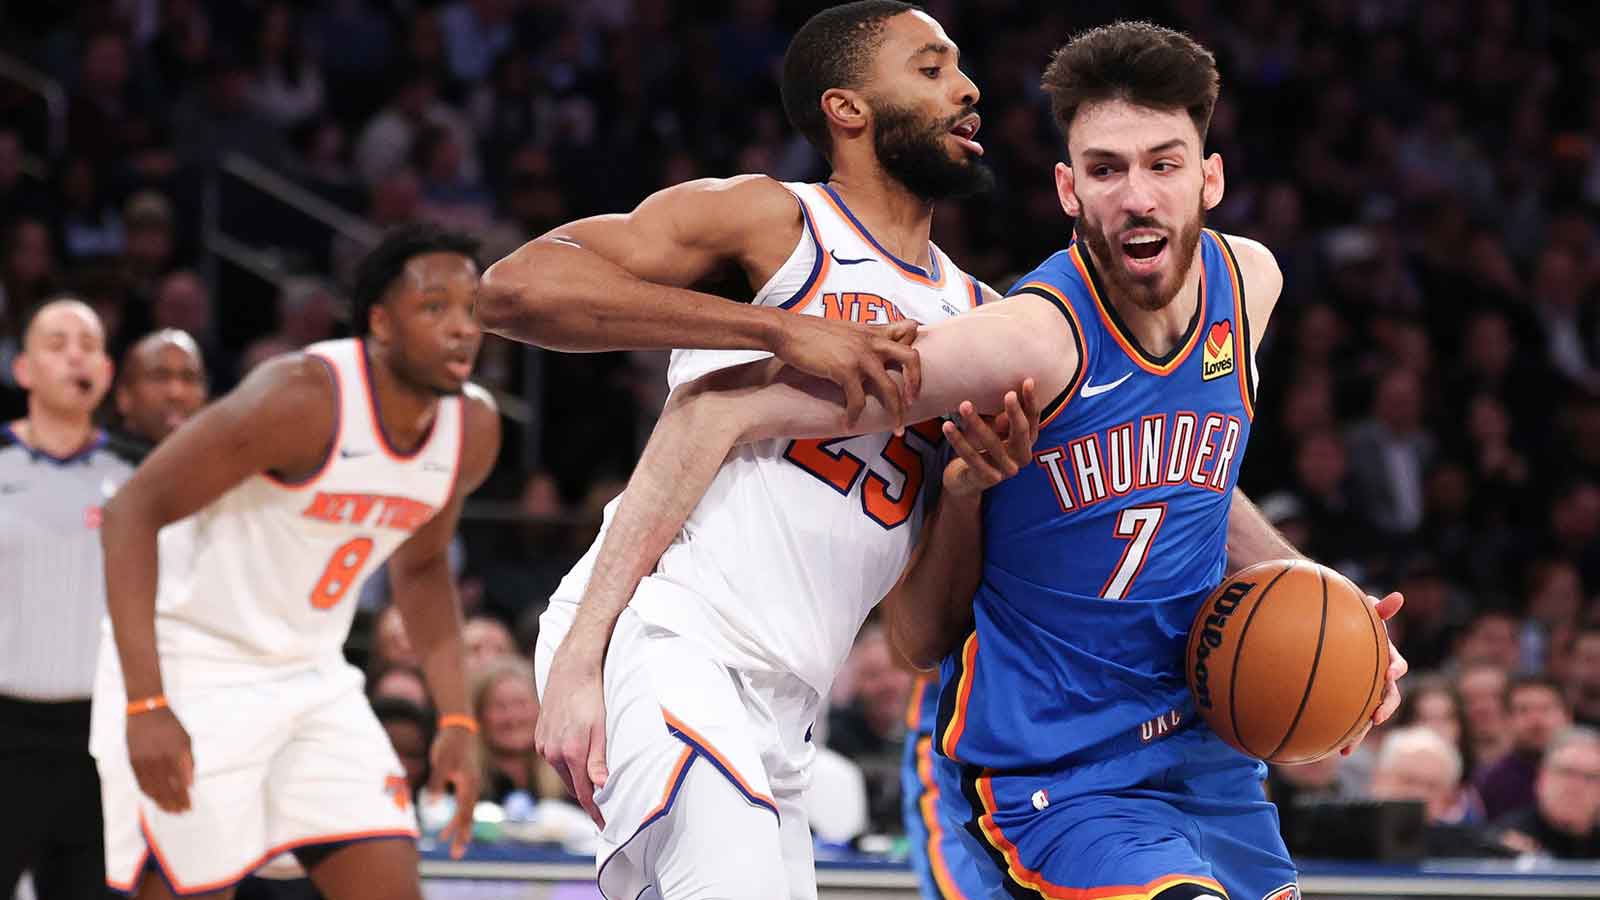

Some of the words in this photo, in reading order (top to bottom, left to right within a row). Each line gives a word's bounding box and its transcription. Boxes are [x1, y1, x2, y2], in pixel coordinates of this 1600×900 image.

[1204, 353, 1232, 376] Love's
[1033, 410, 1241, 512] THUNDER
[309, 536, 374, 610] 8
[1099, 502, 1168, 600] 7
[1194, 581, 1257, 708] Wilson
